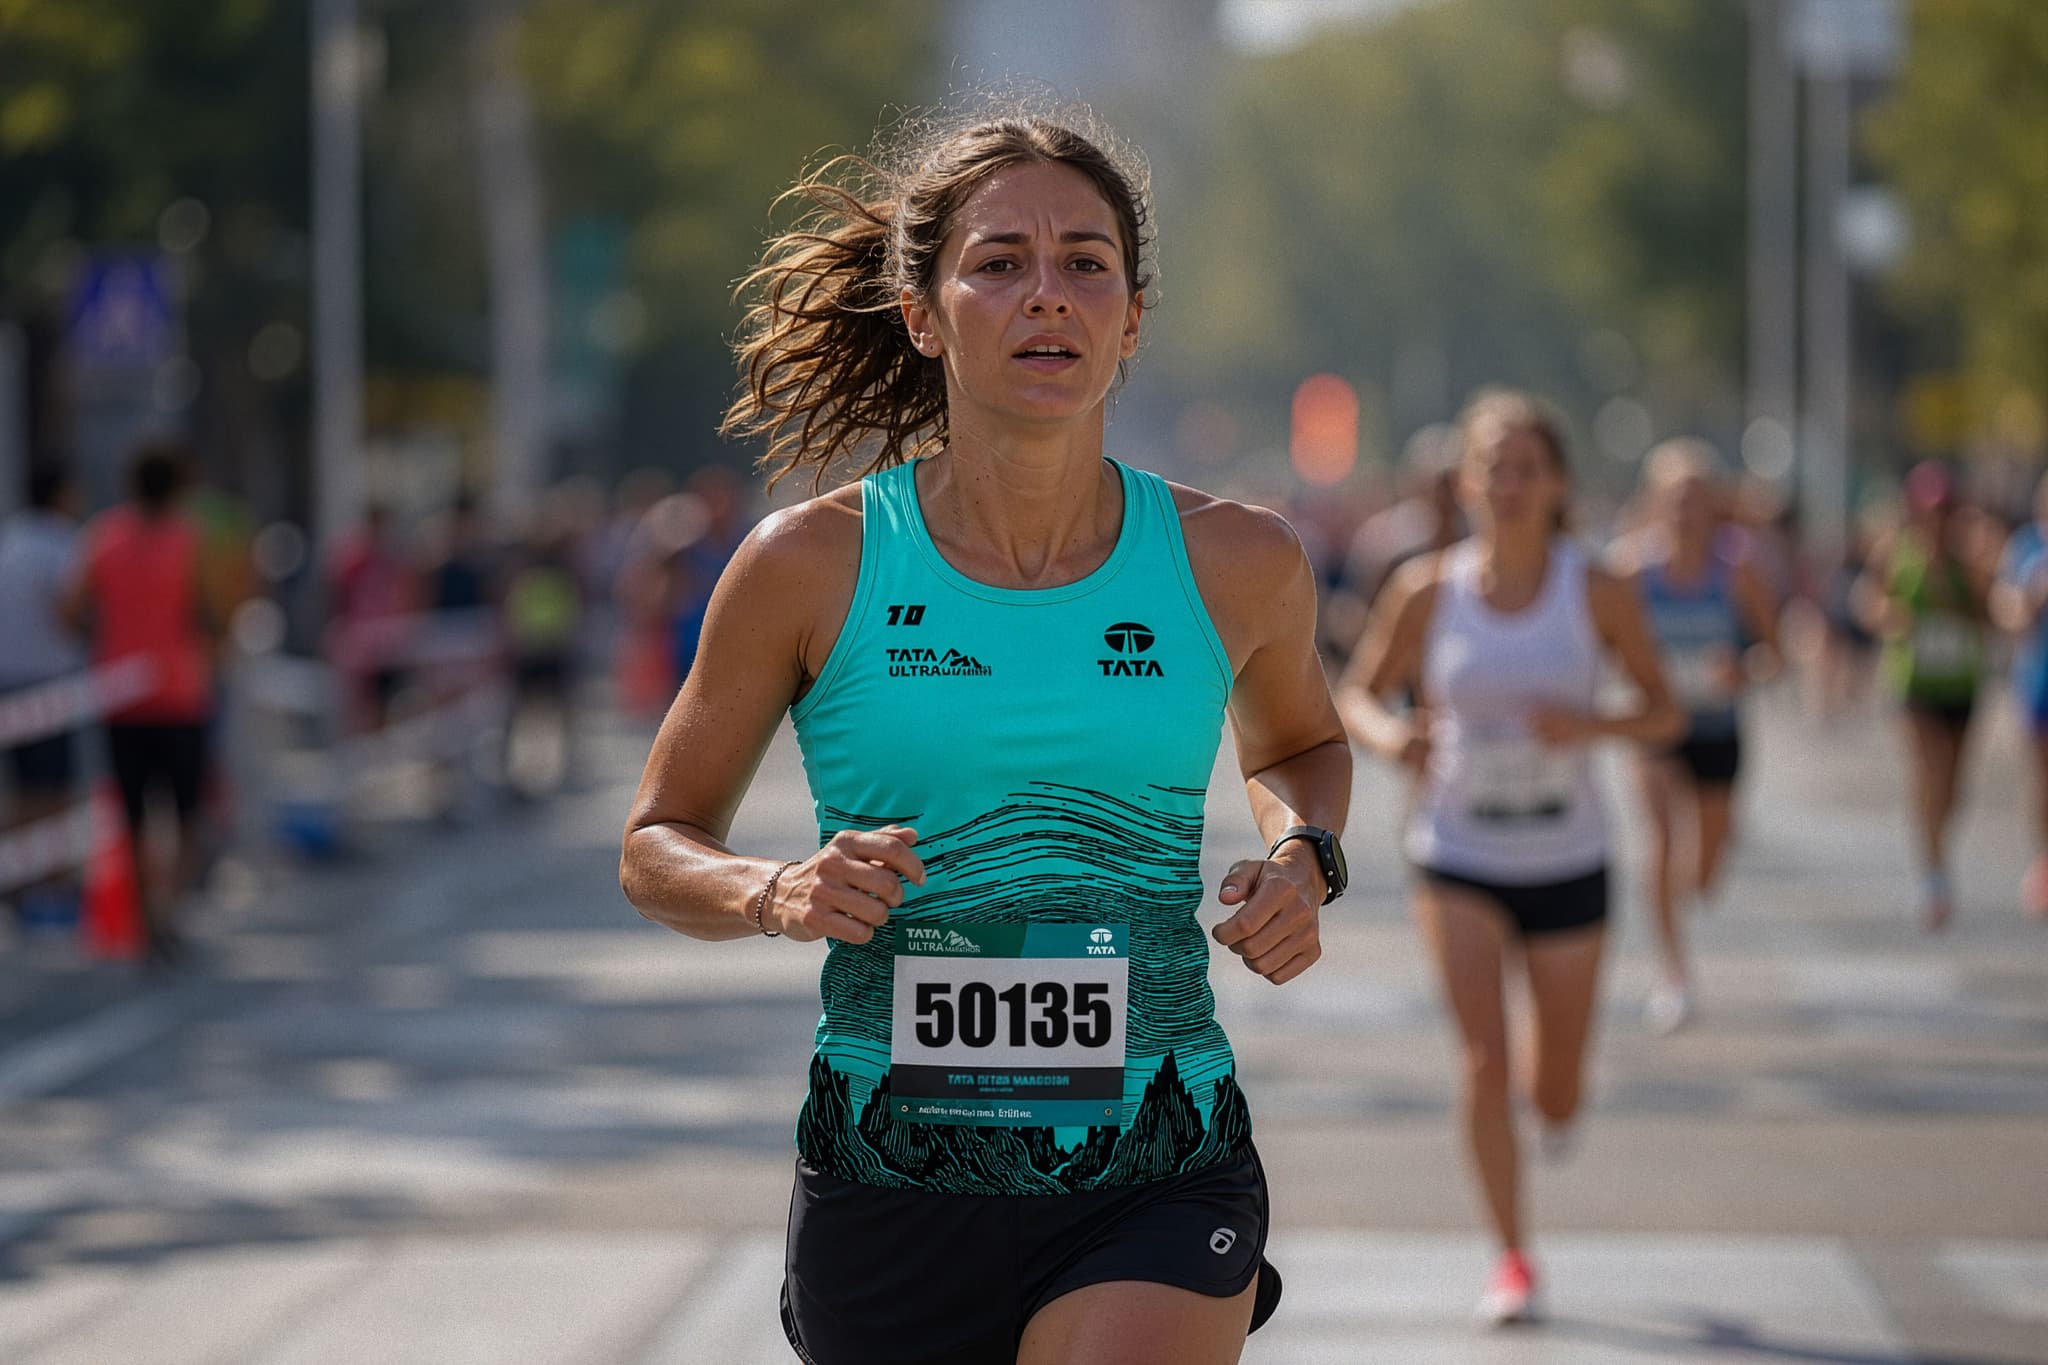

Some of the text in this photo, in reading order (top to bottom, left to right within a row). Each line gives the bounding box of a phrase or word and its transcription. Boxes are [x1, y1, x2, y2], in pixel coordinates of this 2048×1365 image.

[886, 648, 937, 662] TATA
[1097, 660, 1164, 677] TATA
[906, 928, 941, 939] TATA
[1086, 946, 1116, 955] TATA
[915, 982, 1112, 1048] 50135
